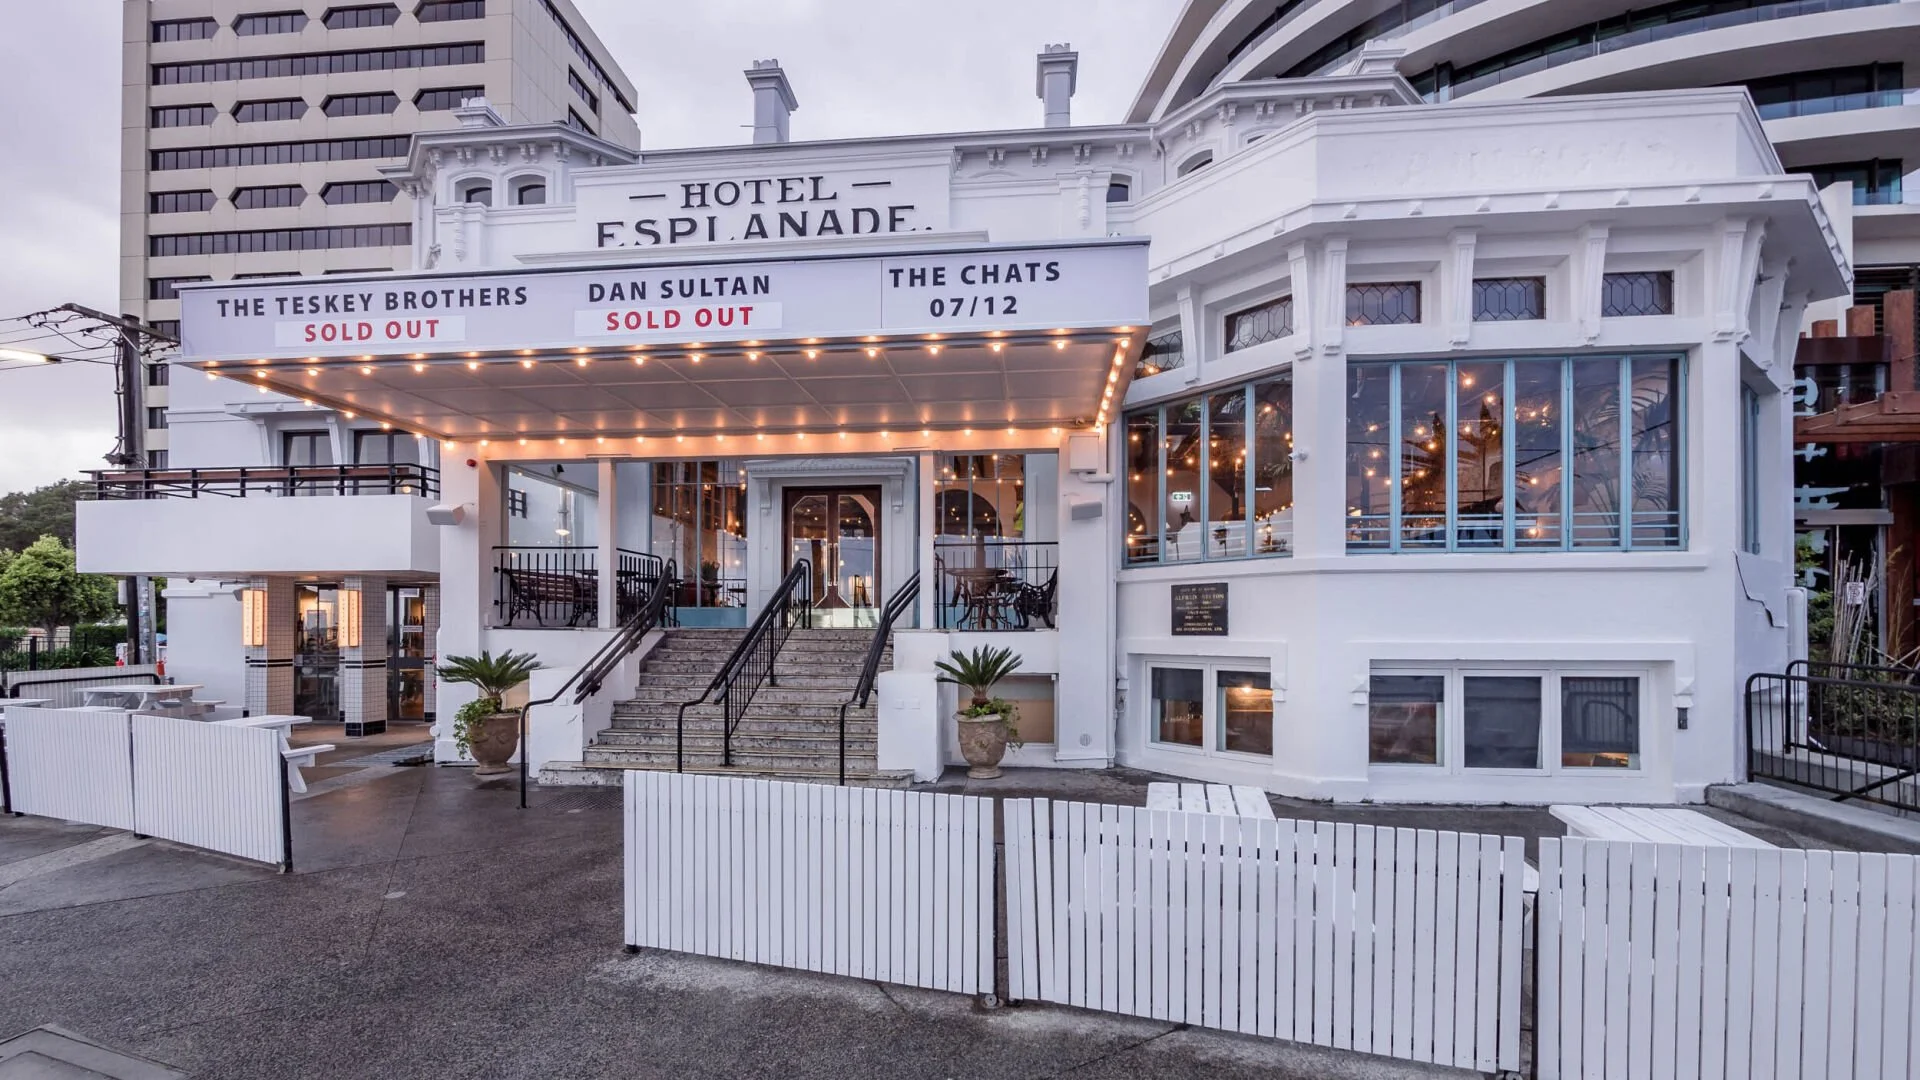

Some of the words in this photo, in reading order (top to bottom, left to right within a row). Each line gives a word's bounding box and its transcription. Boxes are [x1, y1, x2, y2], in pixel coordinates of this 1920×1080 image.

[680, 175, 838, 209] HOTEL
[588, 280, 648, 303] DAN
[660, 274, 770, 300] SULTAN
[888, 266, 947, 289] THE
[960, 260, 1061, 285] CHATS
[216, 297, 266, 318] THE
[275, 292, 374, 315] TESKEY
[385, 286, 529, 311] BROTHERS
[929, 295, 1018, 318] 07/12
[304, 322, 373, 343] SOLD
[385, 319, 440, 340] OUT
[606, 309, 681, 331] SOLD
[694, 306, 755, 328] OUT
